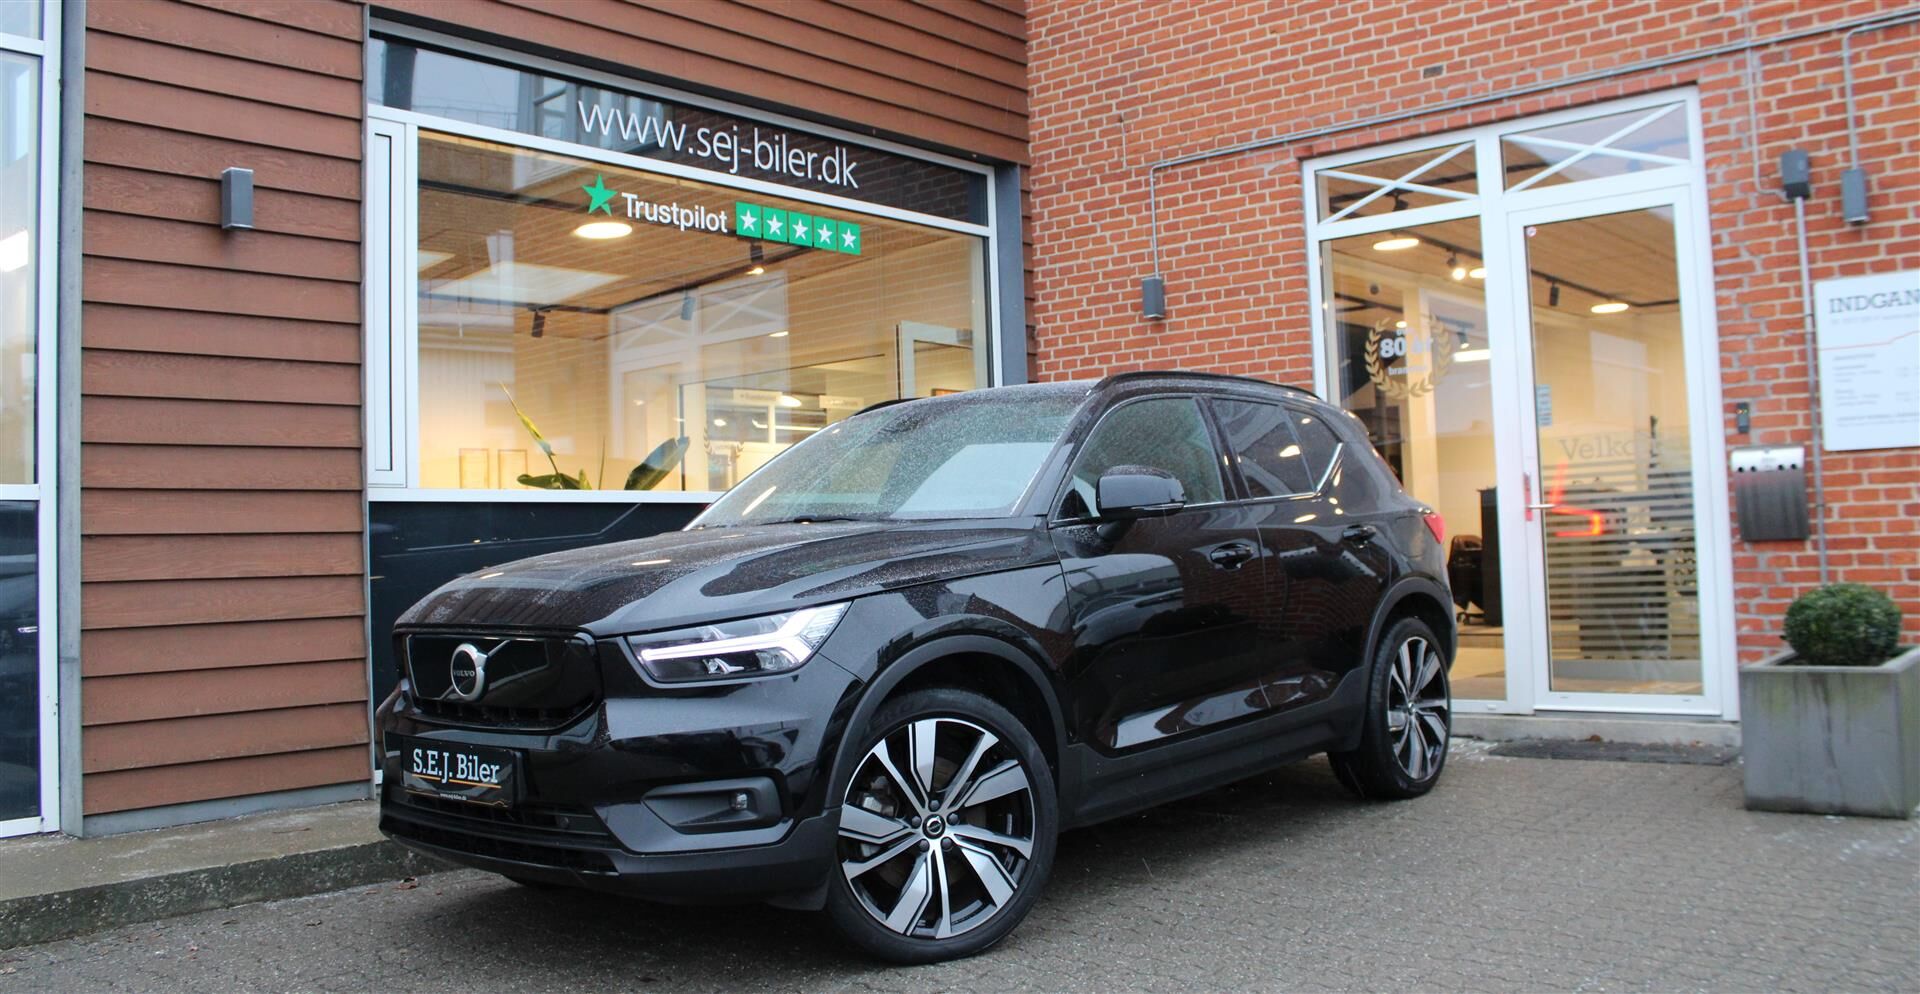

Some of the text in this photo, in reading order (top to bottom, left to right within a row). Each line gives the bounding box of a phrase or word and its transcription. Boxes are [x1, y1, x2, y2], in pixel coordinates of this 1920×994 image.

[578, 100, 859, 189] www.sej-biler.dk
[622, 192, 728, 233] Trustpilot
[1380, 337, 1406, 358] 80
[413, 748, 500, 783] S.E.J. Biler
